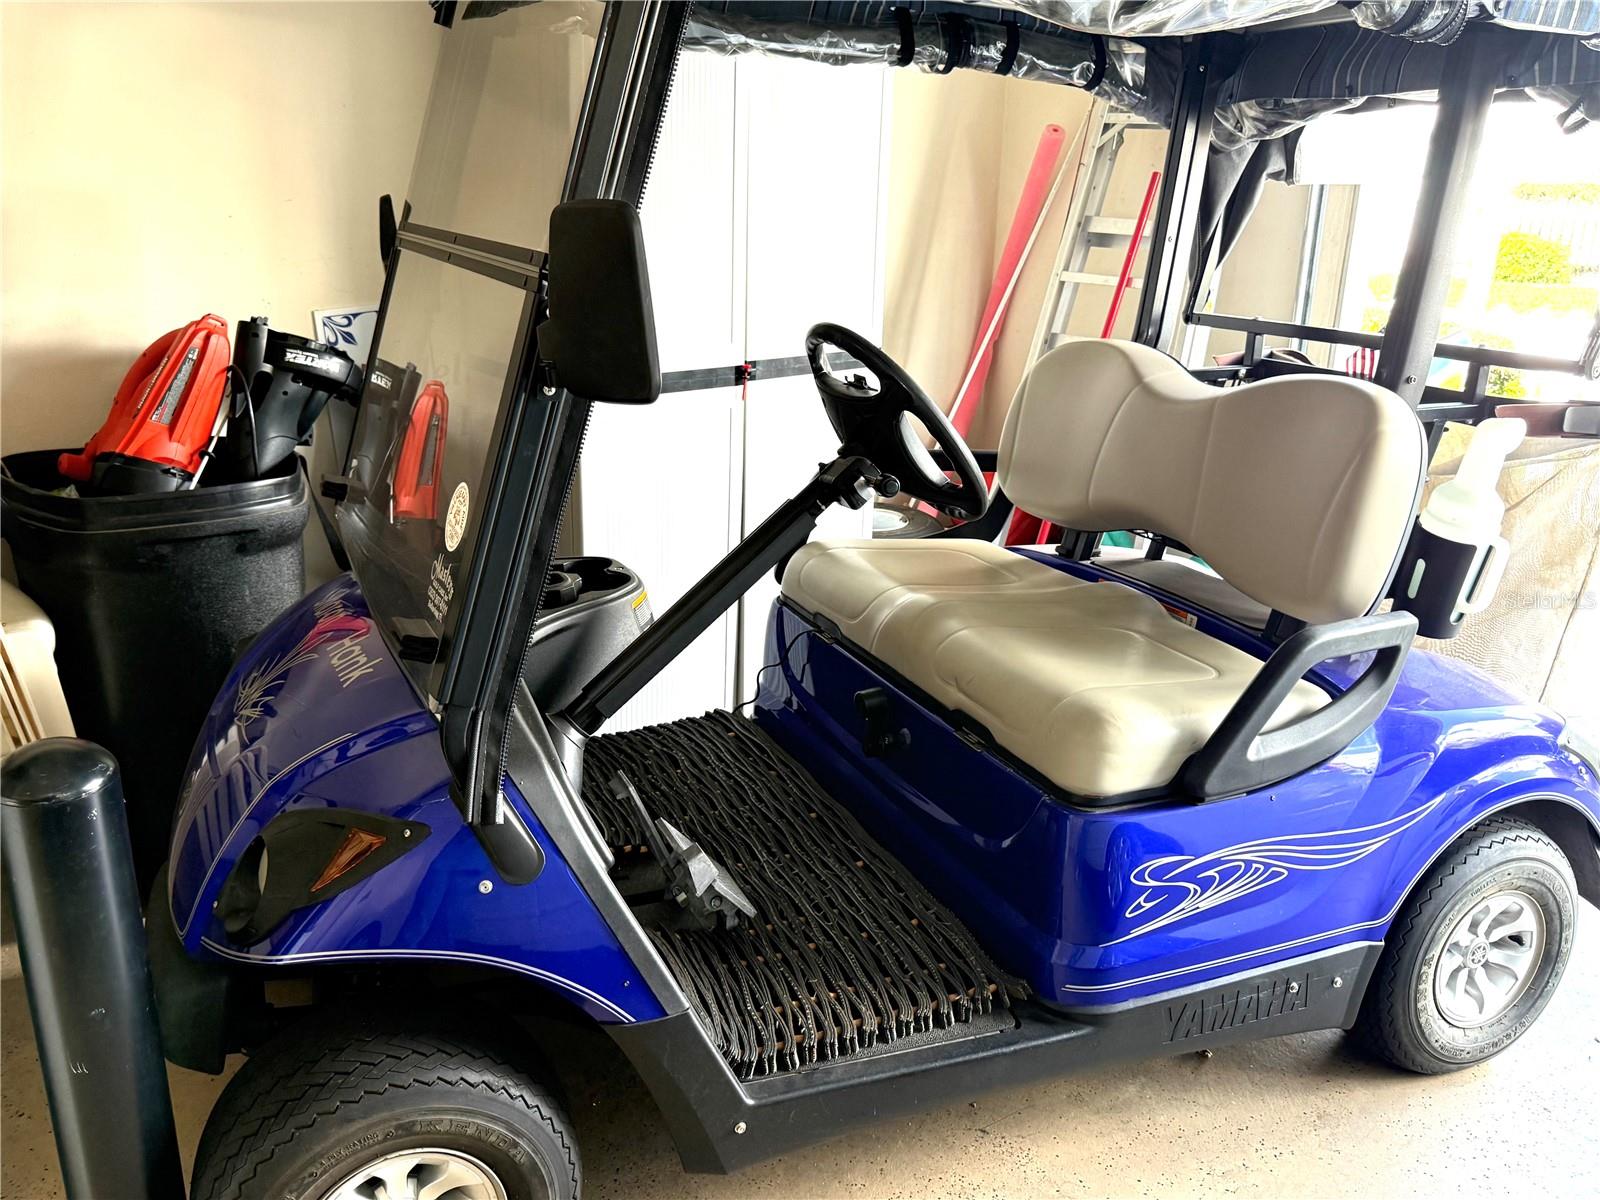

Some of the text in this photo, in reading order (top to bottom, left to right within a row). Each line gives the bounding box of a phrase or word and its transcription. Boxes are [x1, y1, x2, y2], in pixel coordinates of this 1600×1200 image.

[326, 627, 383, 688] Hank
[1162, 973, 1309, 1045] YAMAHA
[419, 1119, 528, 1164] KENDA
